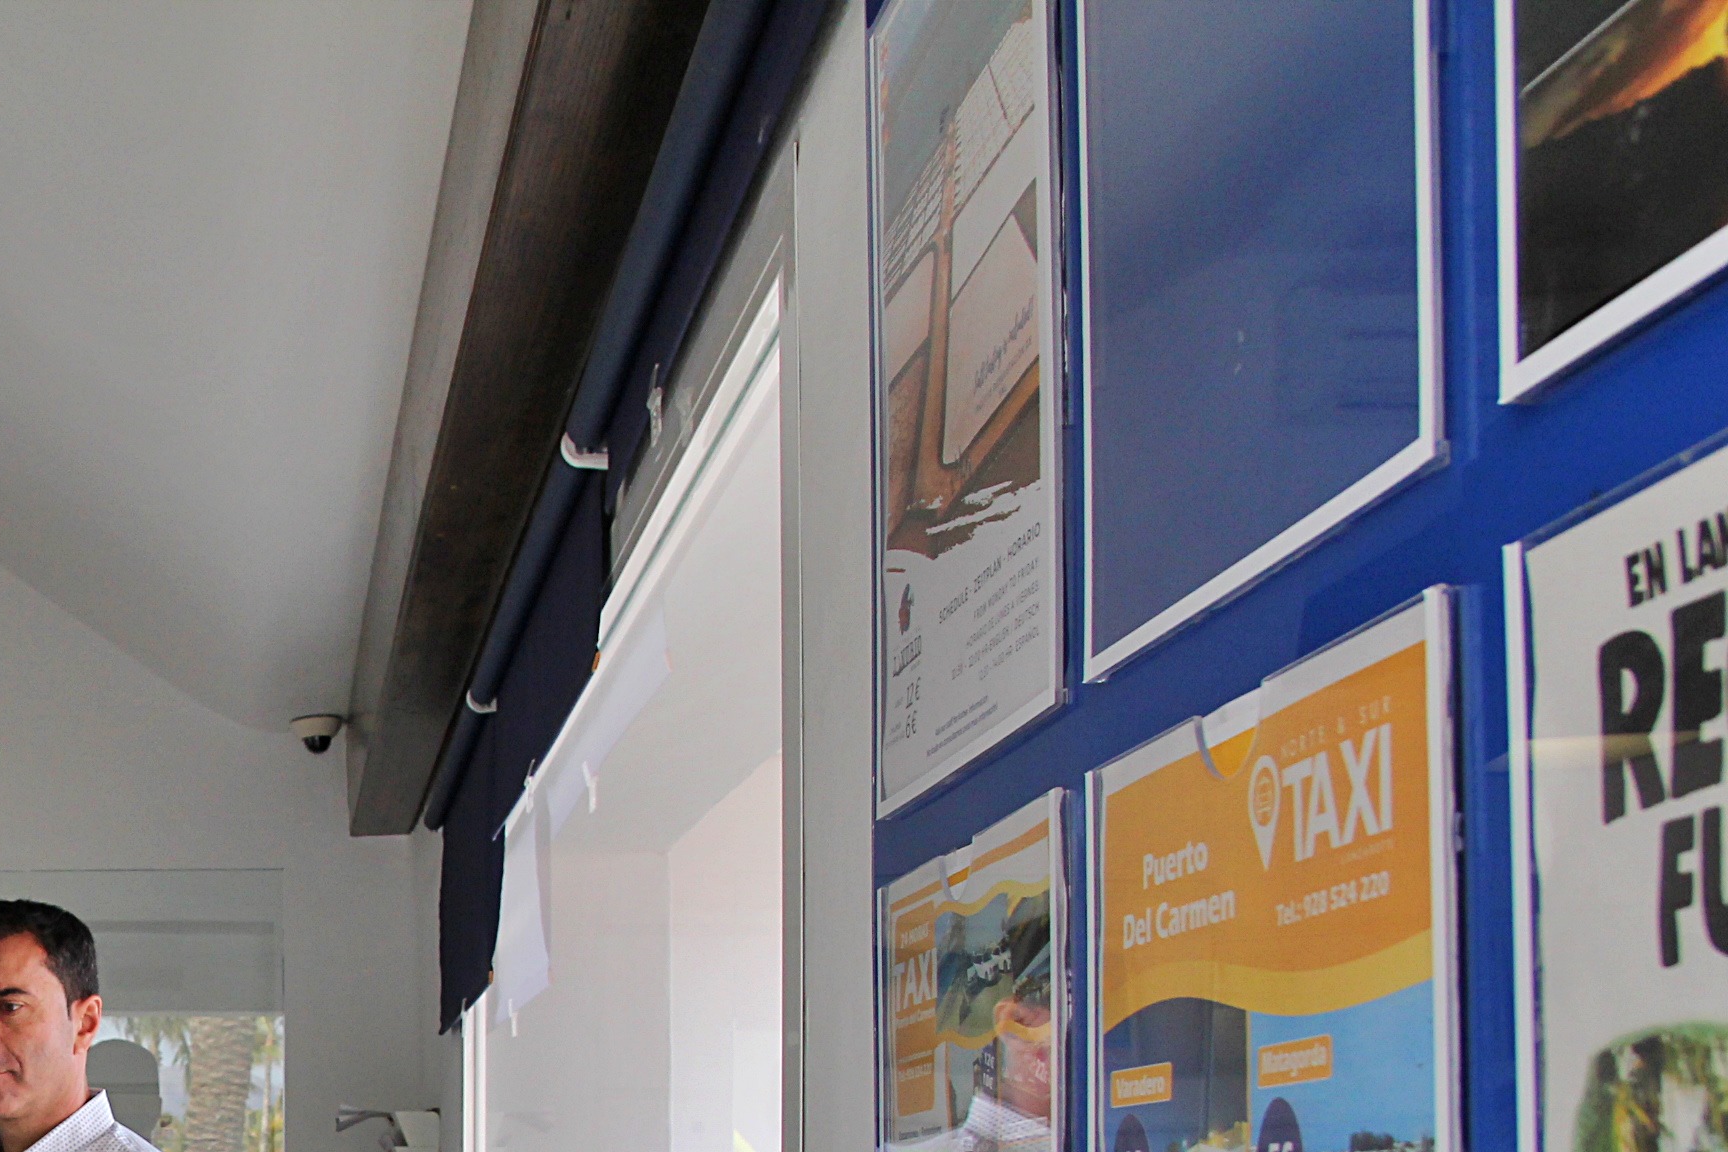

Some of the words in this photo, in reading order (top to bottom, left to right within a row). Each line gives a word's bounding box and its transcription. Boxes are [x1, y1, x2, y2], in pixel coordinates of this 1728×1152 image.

[1007, 522, 1040, 561] HORARIO
[1623, 540, 1667, 608] EN
[1359, 696, 1392, 725] SUR
[1598, 588, 1728, 825] RE
[1282, 722, 1393, 862] TAXI
[1142, 841, 1209, 890] Puerto
[1330, 880, 1357, 910] 524
[1360, 870, 1390, 901] 220
[1123, 907, 1153, 950] Del
[1155, 889, 1236, 939] Carmen
[892, 947, 938, 1013] TAXI
[1259, 1043, 1328, 1079] Matagorda
[1116, 1075, 1166, 1100] Varadero
